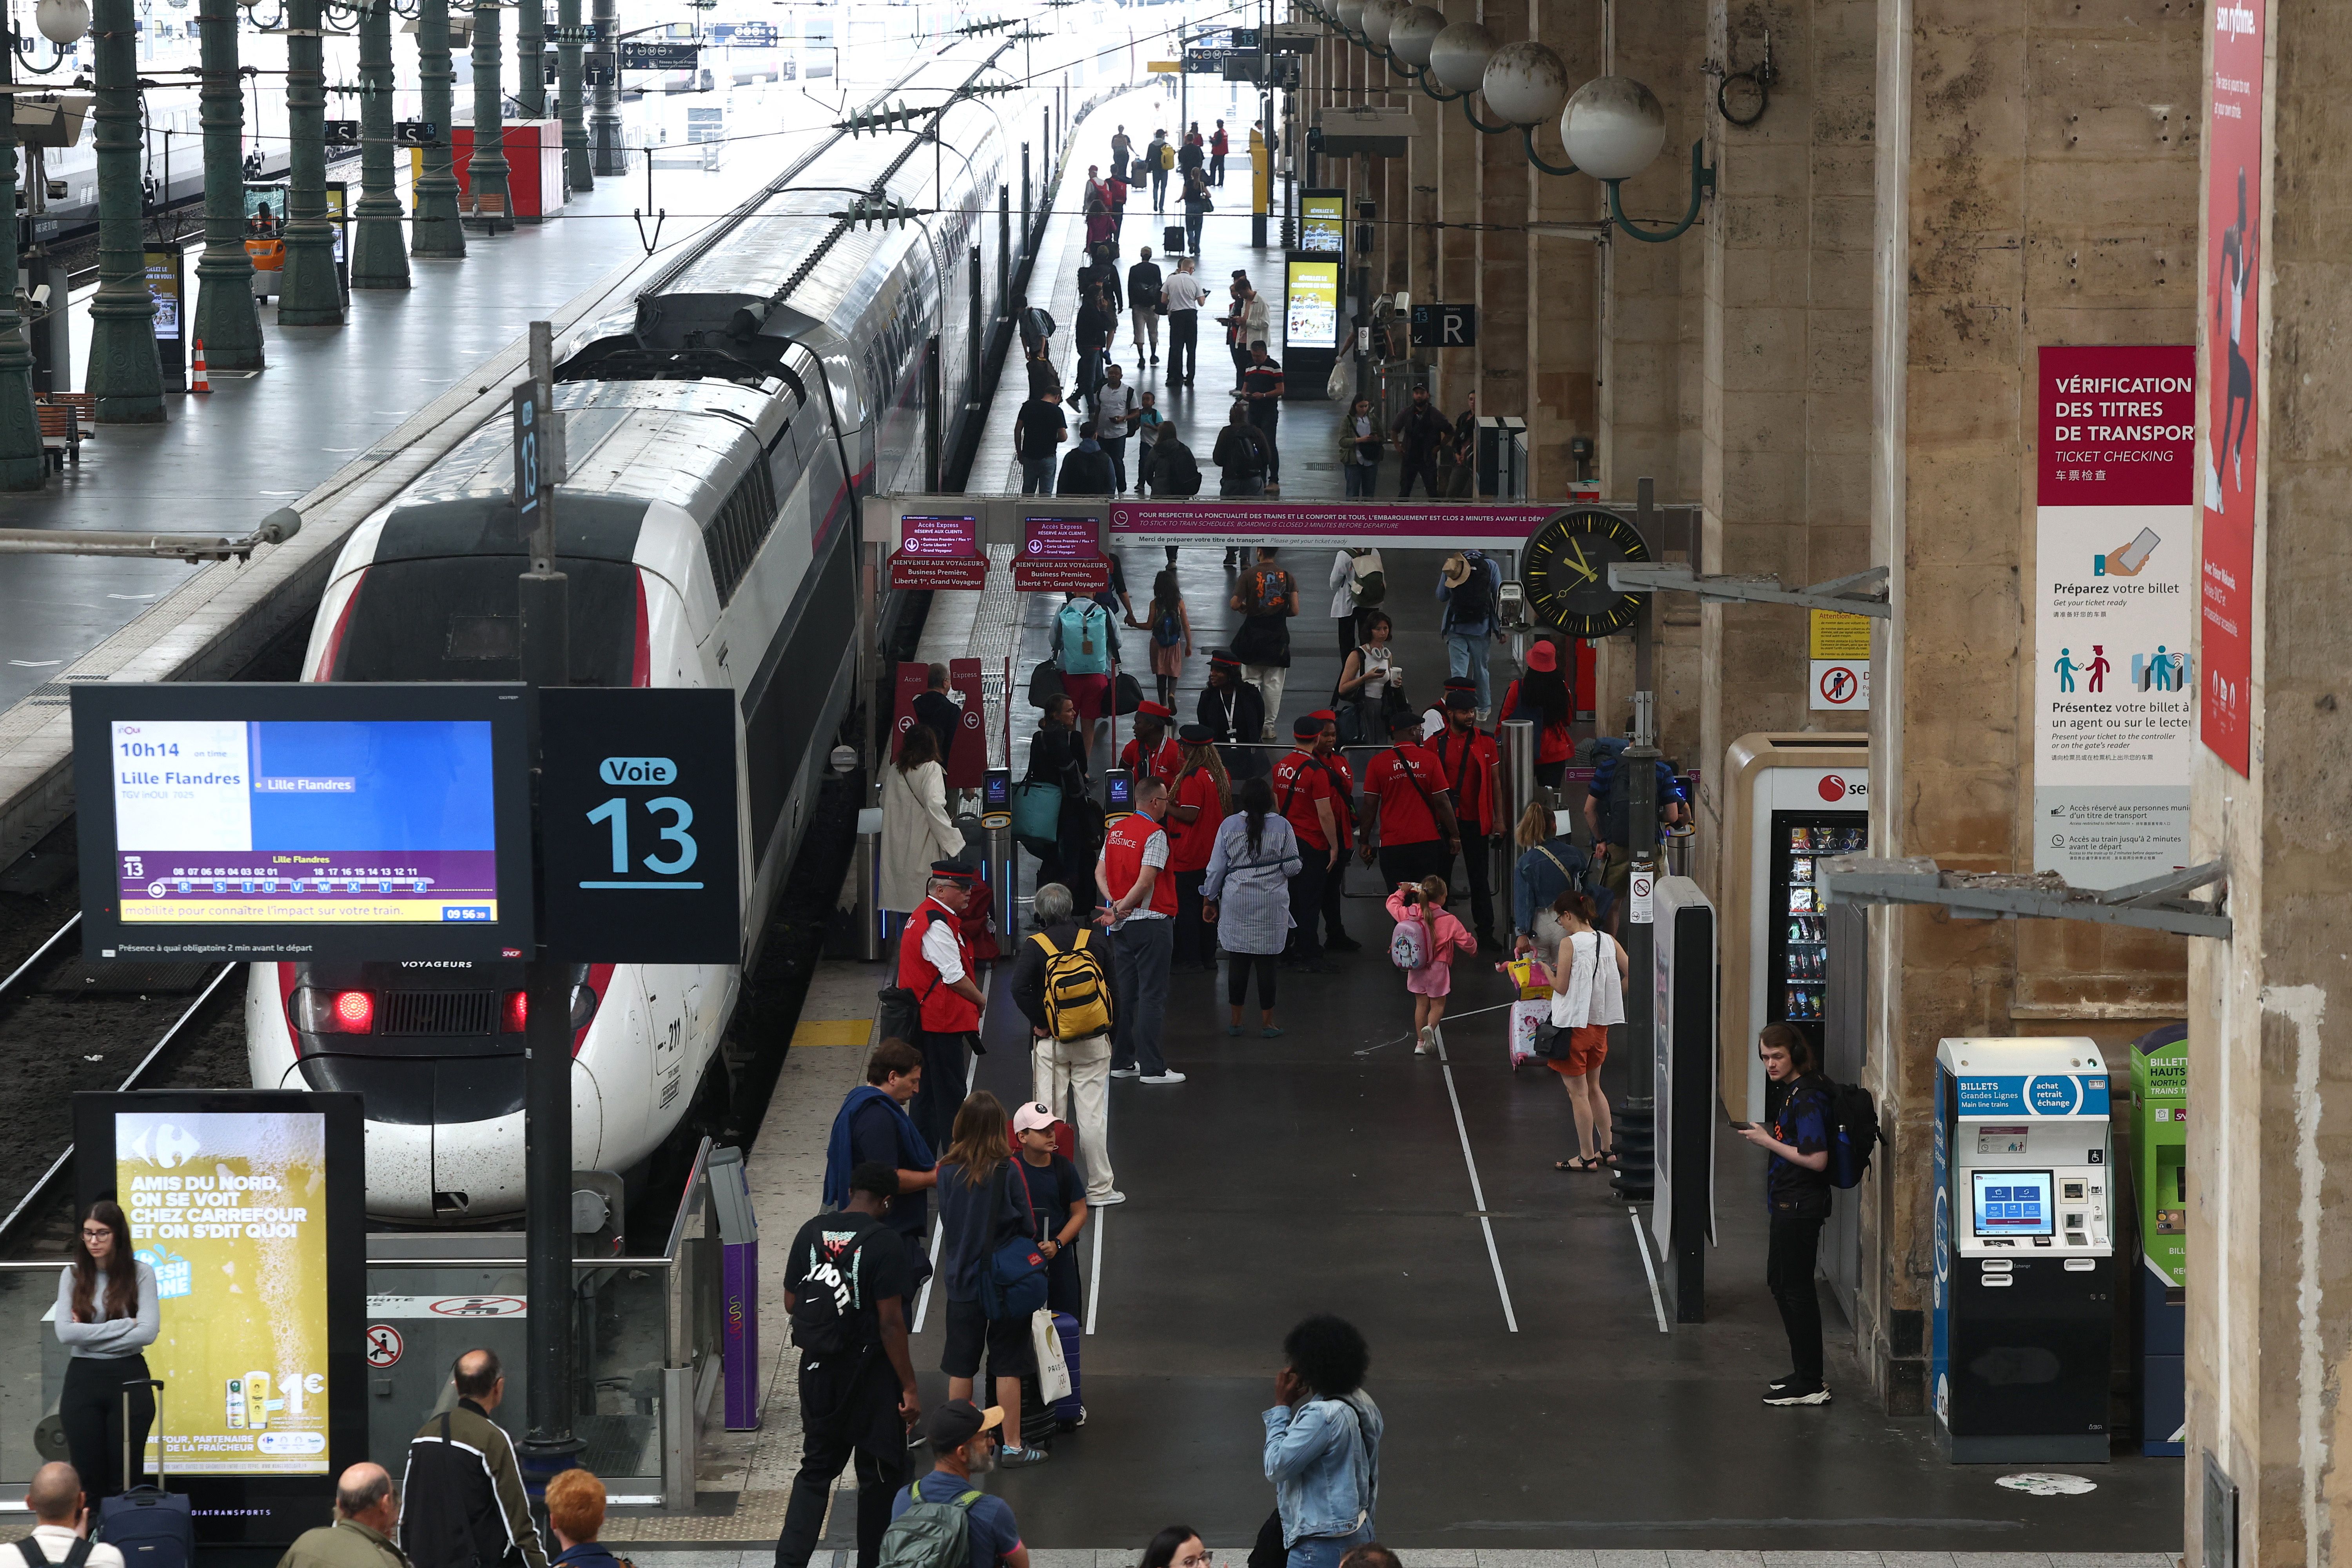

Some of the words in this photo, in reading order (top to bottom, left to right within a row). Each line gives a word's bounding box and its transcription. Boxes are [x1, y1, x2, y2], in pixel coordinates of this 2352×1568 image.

[2217, 6, 2228, 31] son
[2229, 0, 2255, 43] rythme.
[20, 40, 31, 52] U
[1242, 35, 1254, 44] 13
[591, 71, 600, 83] T
[1416, 312, 1428, 321] 13
[1444, 315, 1463, 343] R
[2056, 375, 2192, 393] VÉRIFICATION
[2056, 402, 2092, 417] DES
[2099, 402, 2162, 416] TITRES
[2056, 426, 2082, 441] DE
[2088, 426, 2195, 441] TRANSPOR
[2056, 452, 2101, 462] TICKET
[2104, 451, 2173, 462] CHECKING
[521, 432, 536, 498] 13
[2056, 470, 2106, 481] 车票检查
[2054, 584, 2109, 596] Préparez
[2113, 584, 2144, 593] votre
[2149, 583, 2179, 593] billet
[2053, 703, 2112, 712] Présentez
[2116, 704, 2145, 712] votre
[2150, 702, 2179, 712] billet
[2183, 702, 2189, 711] à
[2070, 719, 2102, 730] agent
[2146, 717, 2155, 727] le
[121, 743, 179, 756] 10h14
[122, 772, 158, 784] Lille
[166, 772, 240, 784] Flandres
[610, 762, 665, 781] Voie
[268, 780, 293, 789] Lille
[297, 780, 351, 789] Flandres
[586, 797, 697, 874] 13
[123, 862, 144, 877] 13
[125, 906, 174, 916] mobilité
[178, 908, 205, 916] pour
[209, 906, 263, 916] connaître
[267, 906, 314, 917] l'impact
[339, 907, 370, 915] votre
[373, 906, 403, 915] train.
[447, 910, 460, 918] 09
[463, 910, 475, 918] 56
[183, 944, 226, 953] obligatoire
[286, 944, 312, 953] départ
[669, 1018, 680, 1052] 211
[131, 1176, 181, 1191] AMIS
[185, 1176, 214, 1191] DU
[219, 1176, 282, 1192] NORD,
[131, 1192, 162, 1207] ON
[165, 1192, 189, 1207] SE
[194, 1192, 240, 1207] VOIT
[131, 1208, 183, 1222] CHEZ
[187, 1208, 307, 1222] CARREFOUR
[131, 1224, 155, 1239] ET
[159, 1224, 189, 1239] ON
[193, 1224, 242, 1239] S'DIT
[246, 1224, 297, 1239] QUOI
[814, 1263, 841, 1287] DO
[198, 1442, 254, 1451] FRAÎCHEUR
